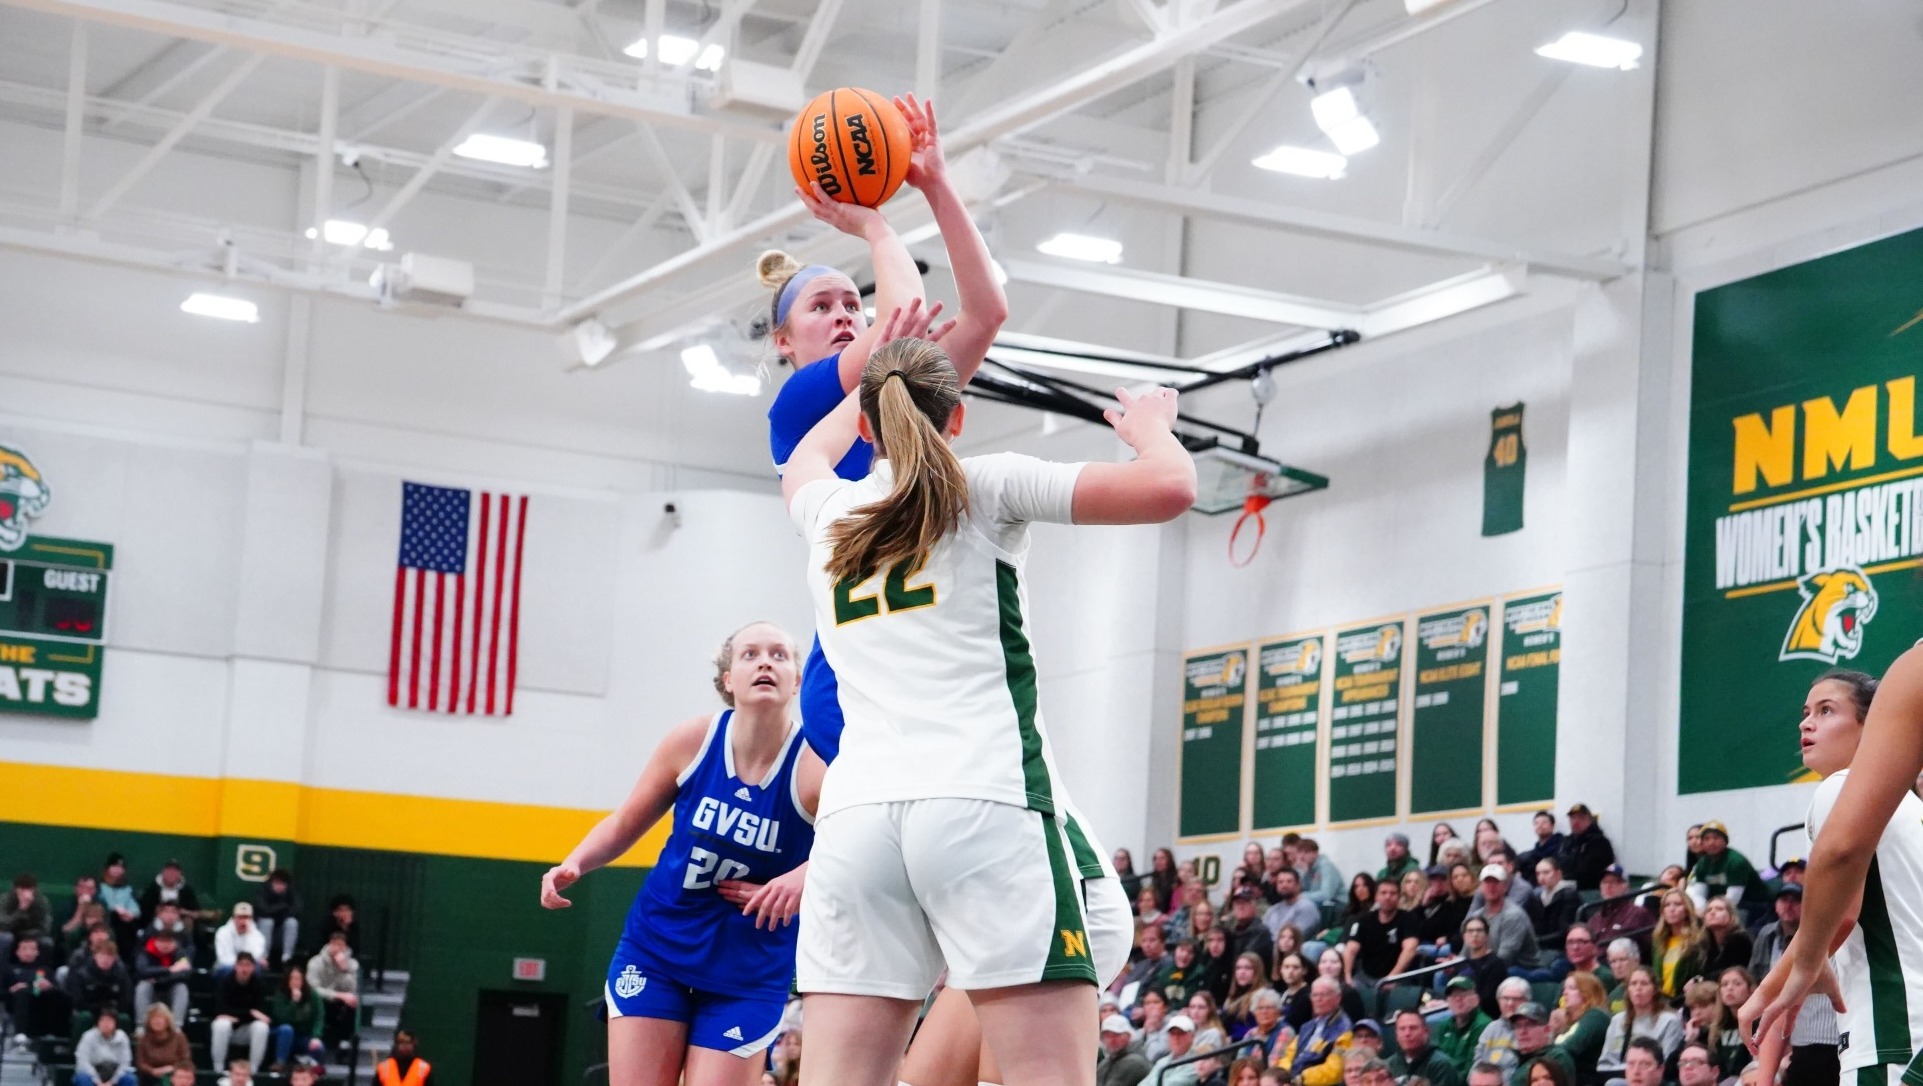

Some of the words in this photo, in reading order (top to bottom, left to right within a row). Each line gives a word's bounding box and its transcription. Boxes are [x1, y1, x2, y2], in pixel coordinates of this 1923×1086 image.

[811, 113, 842, 197] Wilson
[846, 113, 876, 176] NCAA
[1733, 375, 1923, 495] NMU
[1716, 497, 1823, 589] WOMEN'S
[44, 568, 100, 593] GUEST
[833, 547, 937, 627] 22
[691, 796, 780, 853] GVSU
[236, 844, 276, 882] 9
[1060, 929, 1087, 958] N
